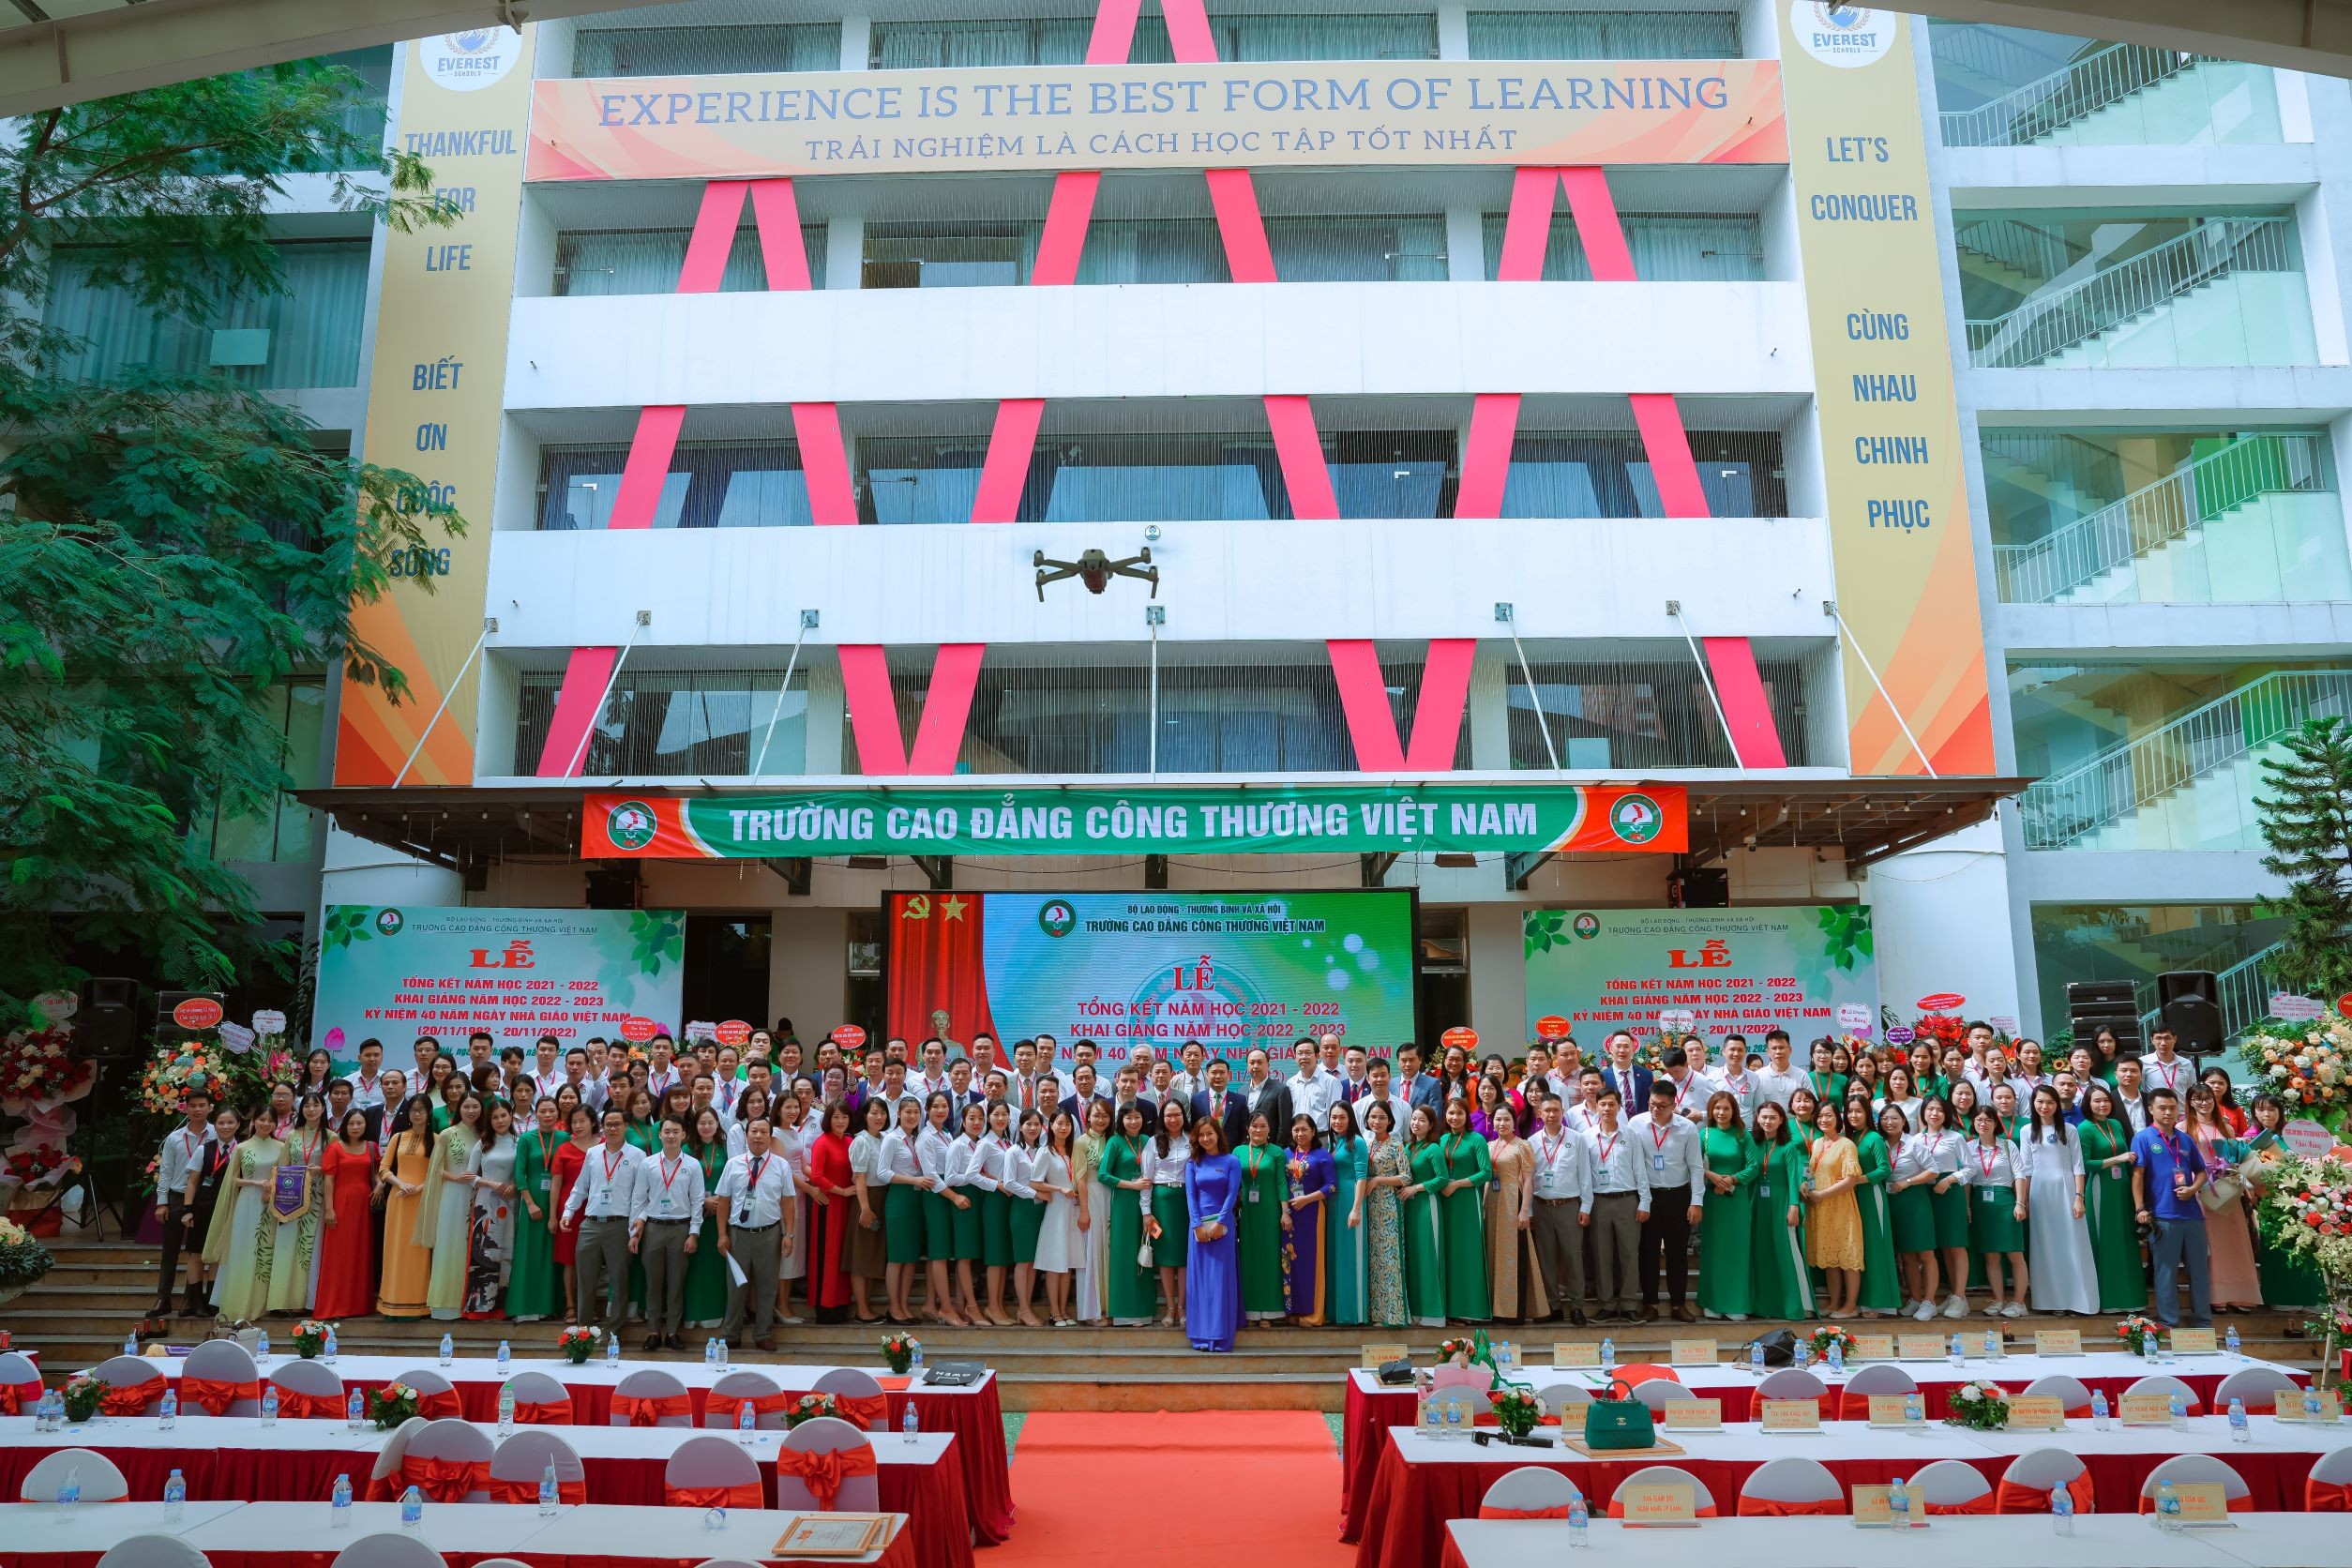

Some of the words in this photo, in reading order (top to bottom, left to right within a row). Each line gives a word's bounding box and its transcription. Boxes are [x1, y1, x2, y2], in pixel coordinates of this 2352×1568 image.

[1813, 33, 1877, 47] EVEREST
[438, 56, 500, 71] EVEREST
[598, 86, 902, 126] EXPERIENCE
[917, 86, 958, 118] IS
[973, 83, 1073, 117] THE
[1089, 81, 1207, 114] BEST
[1224, 79, 1368, 112] FORM
[1386, 78, 1453, 111] OF
[1469, 77, 1728, 110] LEARNING
[405, 129, 516, 158] THANKFUL
[806, 134, 881, 160] TRẢI
[893, 131, 1024, 160] NGHIỆM
[1036, 128, 1077, 156] LÀ
[1089, 126, 1179, 155] CÁCH
[1192, 130, 1260, 155] HỌC
[1272, 127, 1335, 156] TẬP
[1348, 124, 1411, 151] TỐT
[1424, 124, 1517, 150] NHẤT
[1827, 136, 1889, 162] LET'S
[435, 188, 475, 213] FOR
[1811, 194, 1918, 222] CONQUER
[426, 245, 472, 271] LIFE
[1847, 308, 1909, 340] CÙNG
[413, 355, 463, 391] BIẾT
[1853, 375, 1917, 401] NHAU
[415, 423, 447, 451] ƠN
[1855, 436, 1929, 464] CHINH
[1867, 500, 1930, 534] PHỤC
[729, 801, 874, 841] TRƯỜNG
[886, 807, 957, 840] CAO
[970, 792, 1073, 839] ĐẲNG
[1085, 798, 1187, 838] CÔNG
[1199, 800, 1349, 837] THƯƠNG
[1362, 795, 1441, 842] VIỆT
[1452, 802, 1537, 836] NAM
[1127, 903, 1138, 916] BỘ
[1140, 905, 1155, 914] LAO
[1157, 903, 1180, 916] ĐỘNG
[1186, 904, 1219, 914] THƯƠNG
[1220, 905, 1240, 914] BINH
[1242, 903, 1253, 914] VÀ
[1254, 903, 1266, 914] XÃ
[1267, 903, 1281, 916] HỘI
[448, 924, 467, 932] CAO
[579, 925, 597, 934] NAM
[1085, 917, 1129, 932] TRƯỜNG
[1132, 920, 1154, 932] CAO
[1157, 915, 1188, 932] ĐẲNG
[1191, 918, 1222, 932] CÔNG
[1225, 919, 1269, 932] THƯƠNG
[1272, 917, 1296, 936] VIỆT
[1298, 920, 1325, 932] NAM
[1644, 925, 1662, 933] CAO
[469, 940, 535, 969] LỄ
[1666, 939, 1732, 968] LỄ
[402, 974, 435, 988] TỔNG
[438, 975, 461, 989] KẾT
[464, 977, 495, 989] NĂM
[497, 979, 522, 992] HỌC
[526, 980, 555, 990] 2021
[567, 981, 598, 991] 2022
[1172, 954, 1215, 990] LỄ
[1606, 976, 1637, 990] TỔNG
[1640, 977, 1663, 990] KẾT
[1666, 978, 1695, 990] NĂM
[1698, 978, 1723, 990] HỌC
[1726, 978, 1754, 988] 2021
[1767, 977, 1796, 988] 2022
[394, 993, 424, 1004] KHAI
[428, 991, 466, 1004] GIẢNG
[469, 993, 499, 1005] NĂM
[503, 995, 527, 1007] HỌC
[531, 996, 562, 1006] 2022
[573, 996, 604, 1006] 2023
[1078, 995, 1124, 1016] TỔNG
[1130, 997, 1163, 1016] KẾT
[1168, 999, 1204, 1016] NĂM
[1210, 1003, 1246, 1018] HỌC
[1251, 1003, 1287, 1016] 2021
[1303, 1003, 1339, 1016] 2022
[1600, 996, 1629, 1006] KHAI
[1633, 992, 1669, 1005] GIẢNG
[1673, 993, 1701, 1005] NĂM
[1705, 994, 1729, 1006] HỌC
[1732, 993, 1762, 1003] 2022
[1773, 992, 1803, 1003] 2023
[365, 1006, 381, 1019] KỶ
[384, 1007, 417, 1021] NIỆM
[420, 1009, 436, 1020] 40
[440, 1008, 469, 1020] NĂM
[473, 1008, 506, 1021] NGÀY
[509, 1009, 535, 1021] NHÀ
[539, 1009, 568, 1021] GIÁO
[572, 1011, 599, 1024] VIỆT
[601, 1012, 631, 1022] NAM
[1573, 1008, 1589, 1021] KỶ
[1591, 1009, 1624, 1022] NIỆM
[1627, 1011, 1642, 1020] 40
[1645, 1009, 1662, 1020] NĂ
[1713, 1006, 1740, 1019] NHÀ
[1742, 1006, 1771, 1018] GIÁO
[1774, 1006, 1800, 1020] VIỆT
[1803, 1008, 1832, 1018] NAM
[1070, 1023, 1109, 1036] KHAI
[1115, 1018, 1168, 1037] GIẢNG
[1174, 1020, 1211, 1036] NĂM
[1216, 1023, 1252, 1039] HỌC
[1257, 1023, 1293, 1036] 2022
[1309, 1023, 1346, 1036] 2023
[1108, 1048, 1125, 1060] 40
[1267, 1042, 1297, 1060] GIÁ
